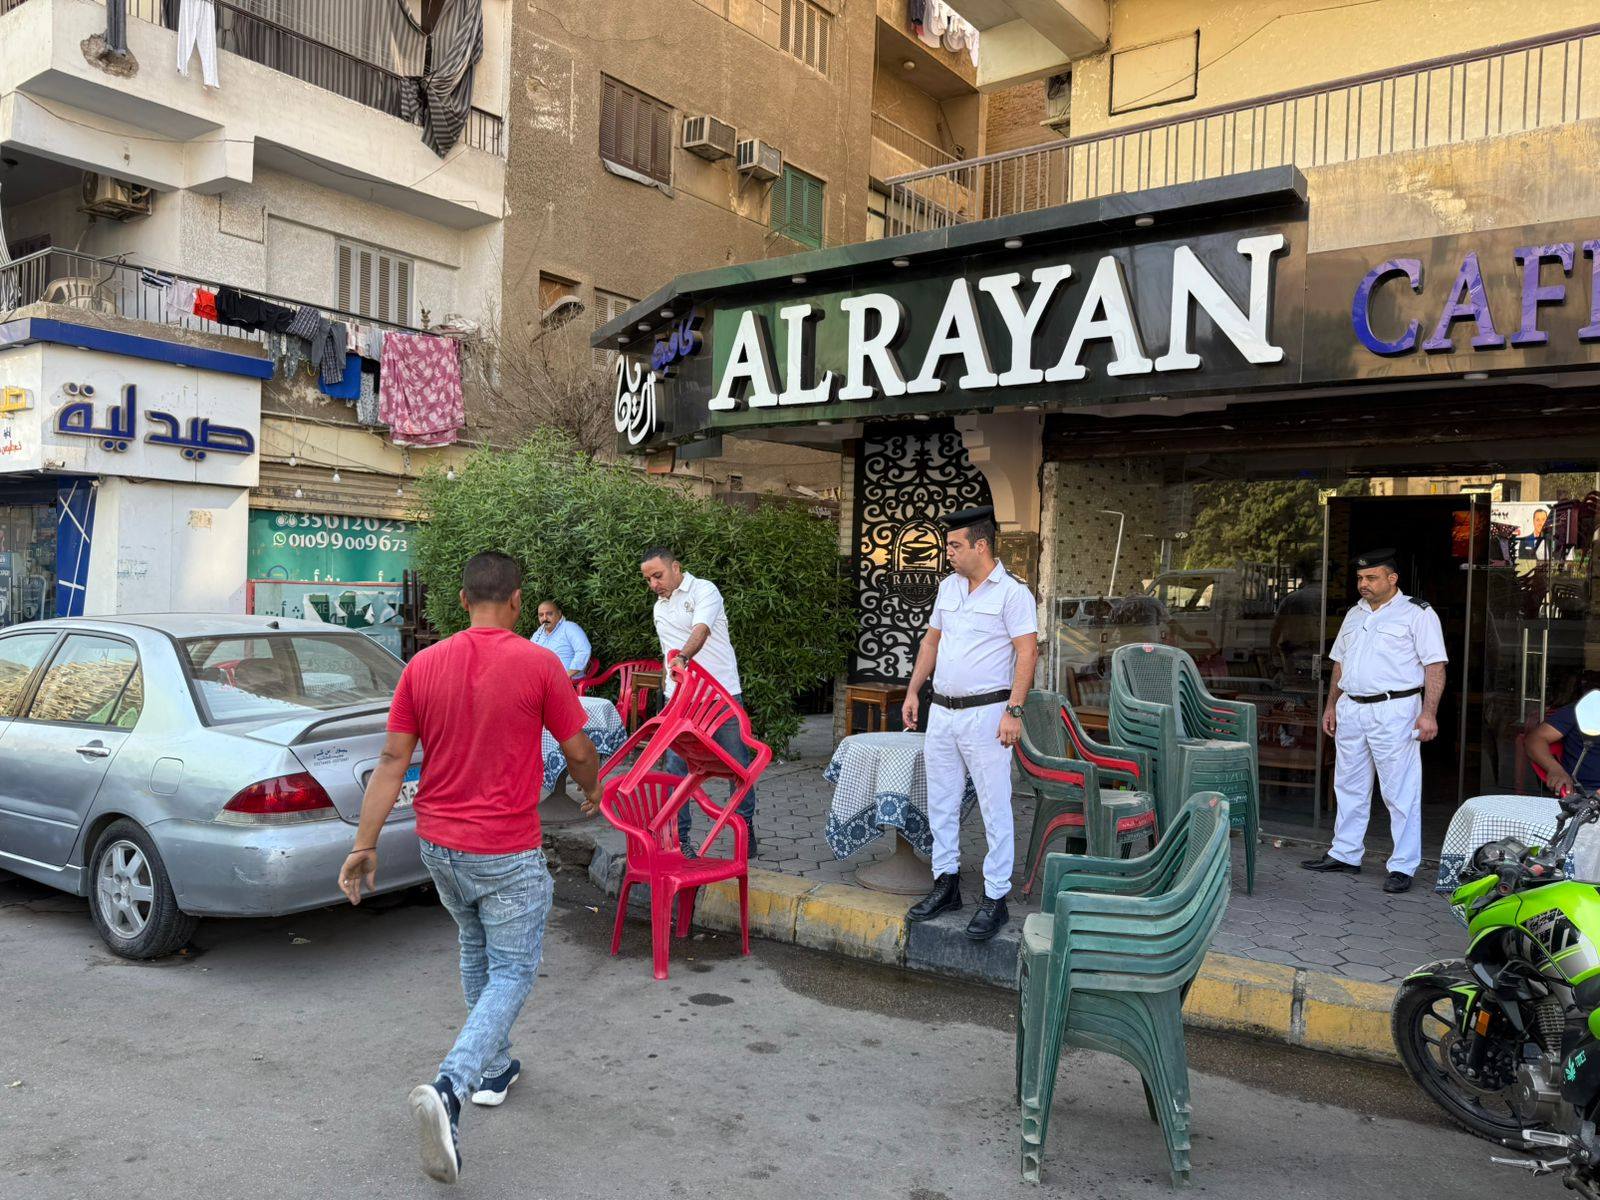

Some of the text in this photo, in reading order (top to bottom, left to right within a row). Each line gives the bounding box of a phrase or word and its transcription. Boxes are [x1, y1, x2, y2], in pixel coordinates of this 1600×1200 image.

[708, 233, 1285, 412] ALRAYAN
[53, 382, 255, 460] صيدلية
[289, 531, 408, 552] 01099009673
